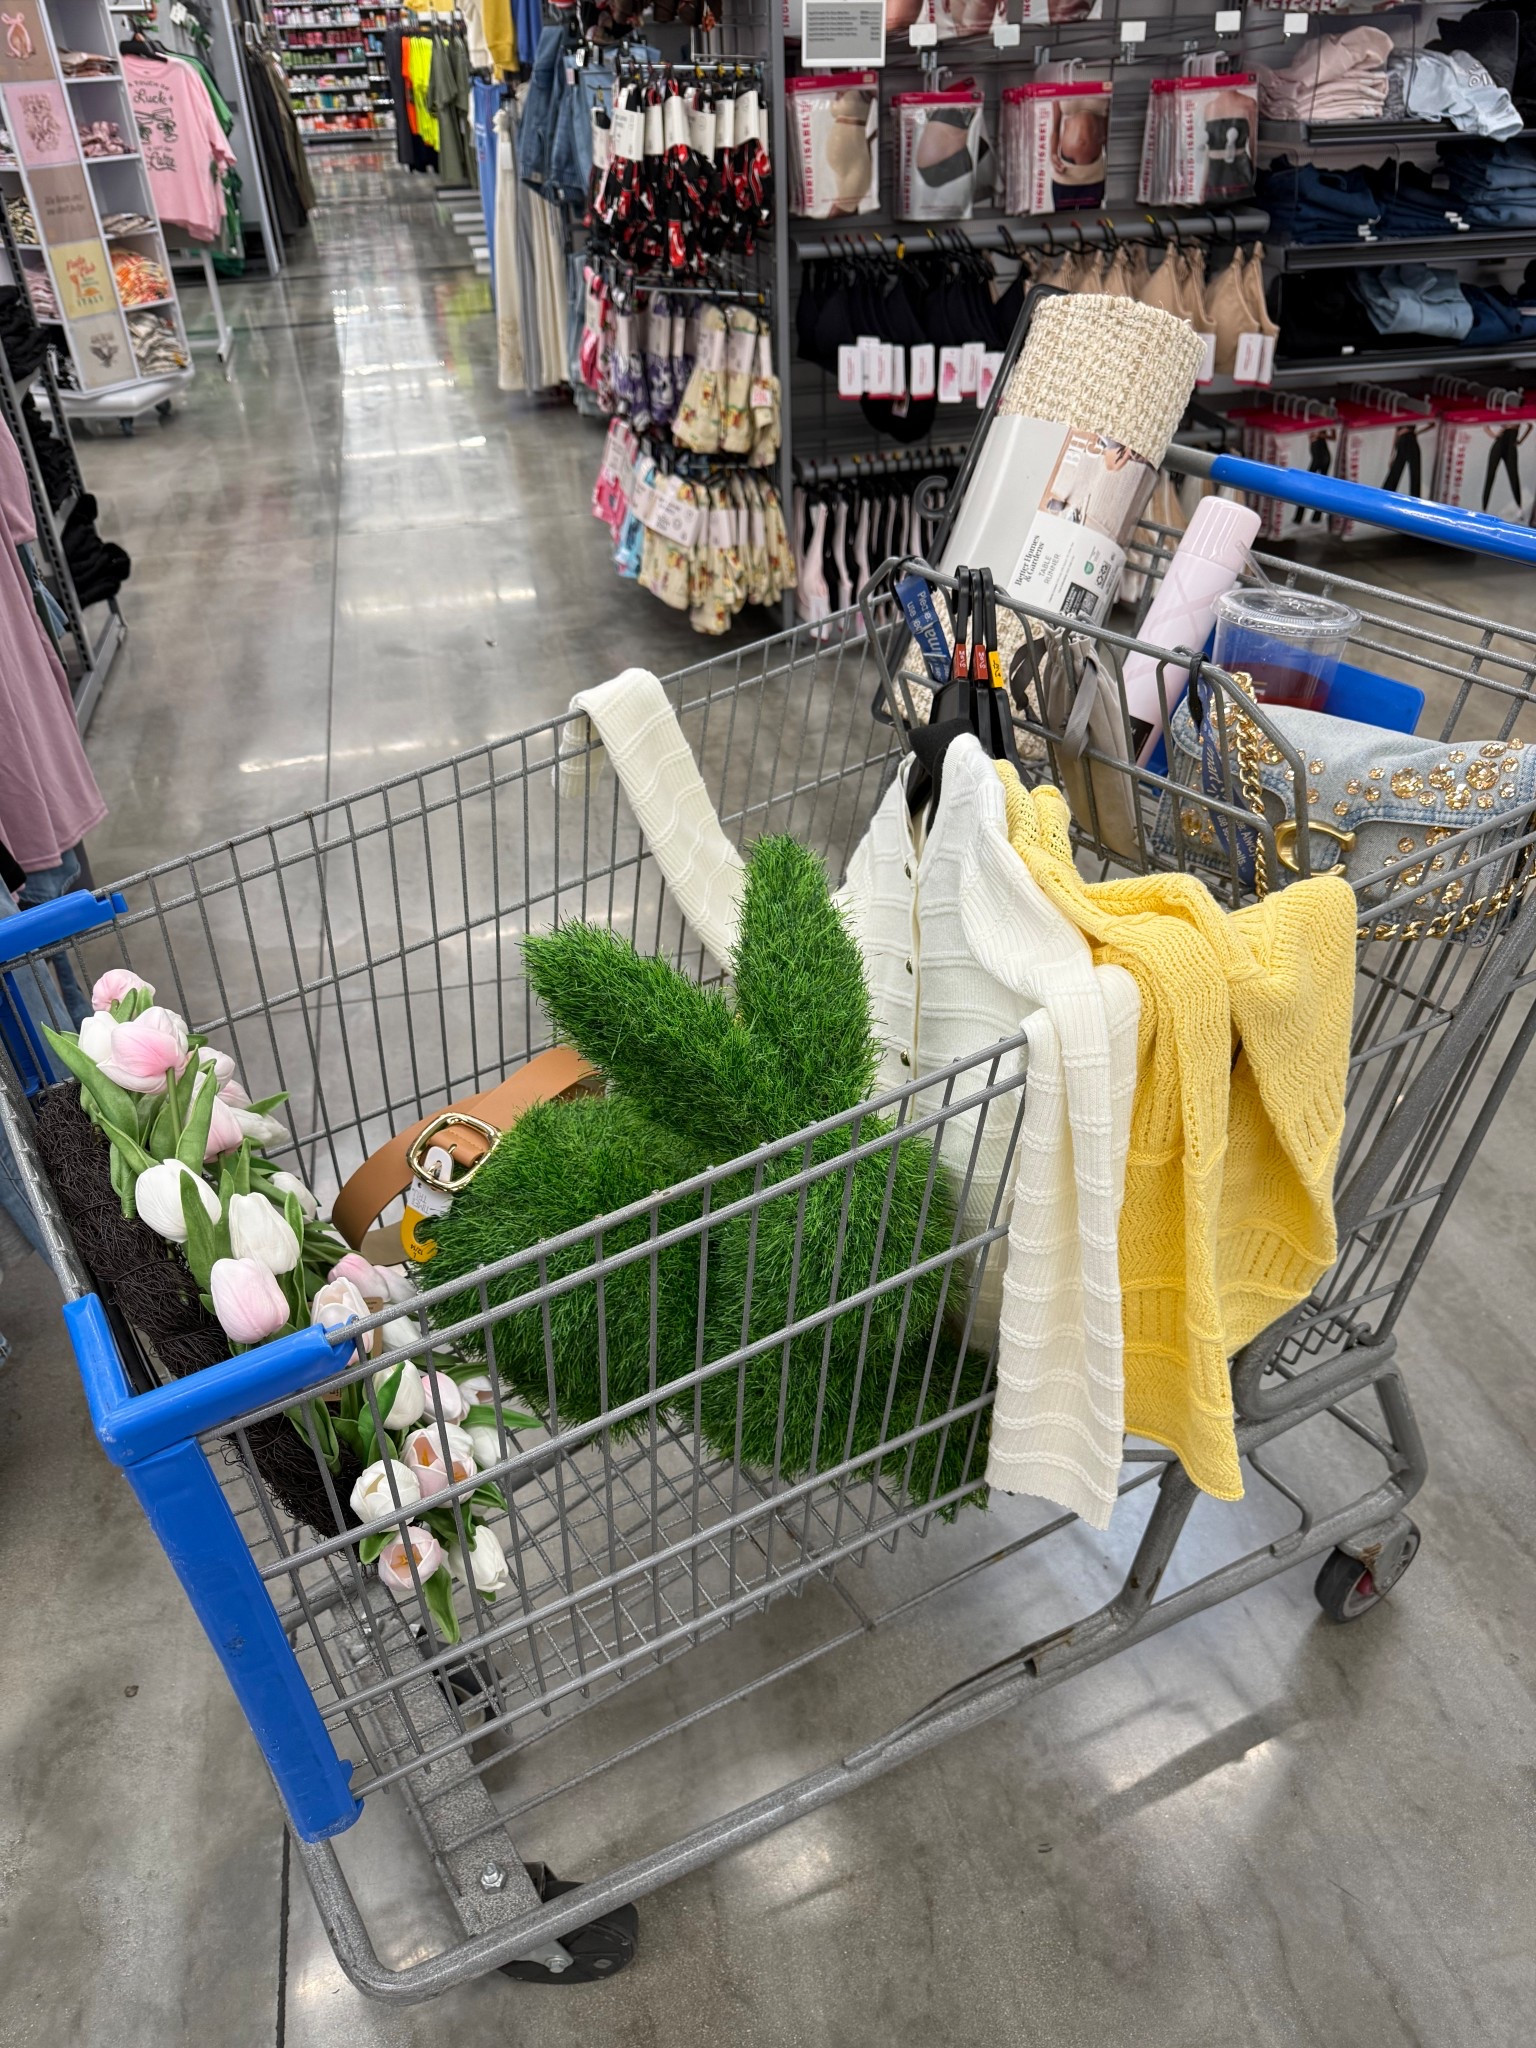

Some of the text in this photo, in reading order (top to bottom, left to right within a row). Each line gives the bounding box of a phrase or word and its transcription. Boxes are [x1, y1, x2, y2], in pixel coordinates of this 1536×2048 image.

[802, 115, 812, 159] ISABEL
[1037, 122, 1047, 164] ISABEL
[804, 167, 814, 208] INGRID
[1014, 534, 1040, 587] Better Homes
[1028, 541, 1045, 576] Gardens
[1038, 554, 1053, 578] TABLE
[1043, 553, 1061, 585] RUNNER
[907, 601, 917, 617] use
[917, 590, 933, 623] Pleae:
[410, 1244, 424, 1256] 12/14
